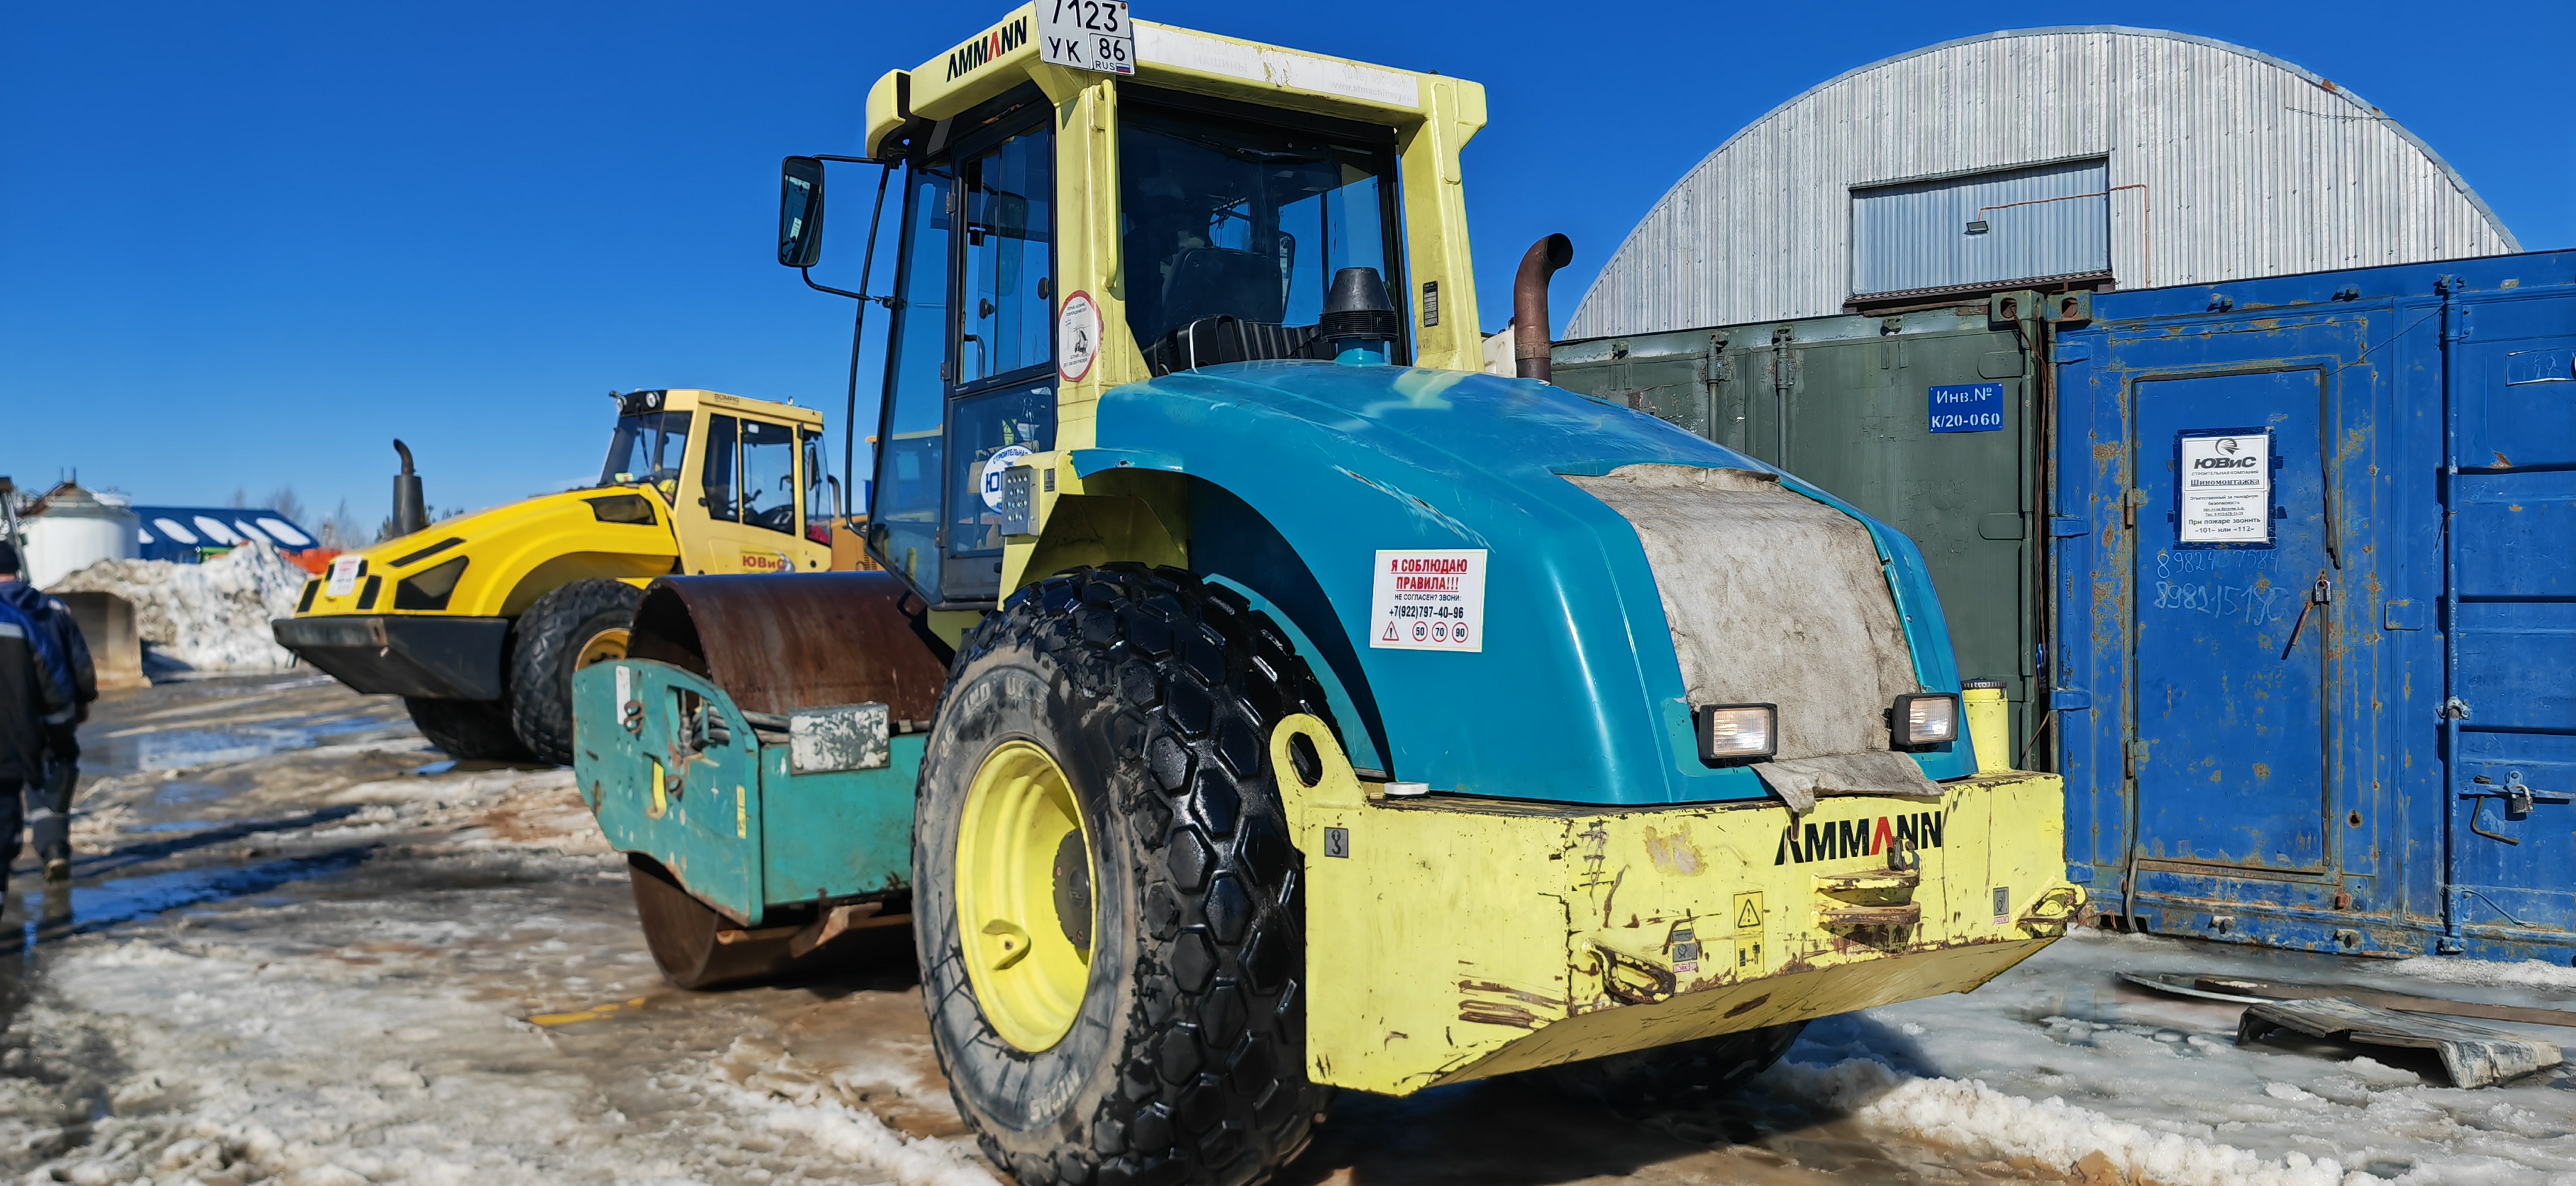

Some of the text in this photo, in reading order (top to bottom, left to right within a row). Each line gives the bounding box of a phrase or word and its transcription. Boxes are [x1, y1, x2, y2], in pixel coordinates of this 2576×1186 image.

[946, 15, 1027, 82] AMMANN
[1098, 38, 1126, 61] 86
[1095, 59, 1116, 71] RUS
[1937, 387, 1992, 404] Инв.№
[1932, 413, 2000, 428] К/20-060
[2194, 456, 2257, 469] ЮВиС
[2190, 479, 2260, 487] Шиномонтажка
[1391, 559, 1468, 574] Я СОБЛЮДАЮ
[1396, 576, 1459, 590] ПРАВИЛА!!!
[1389, 605, 1464, 620] +7(922)797-40-96
[1416, 627, 1465, 637] 50 70 90
[1774, 811, 1942, 866] AMMANN
